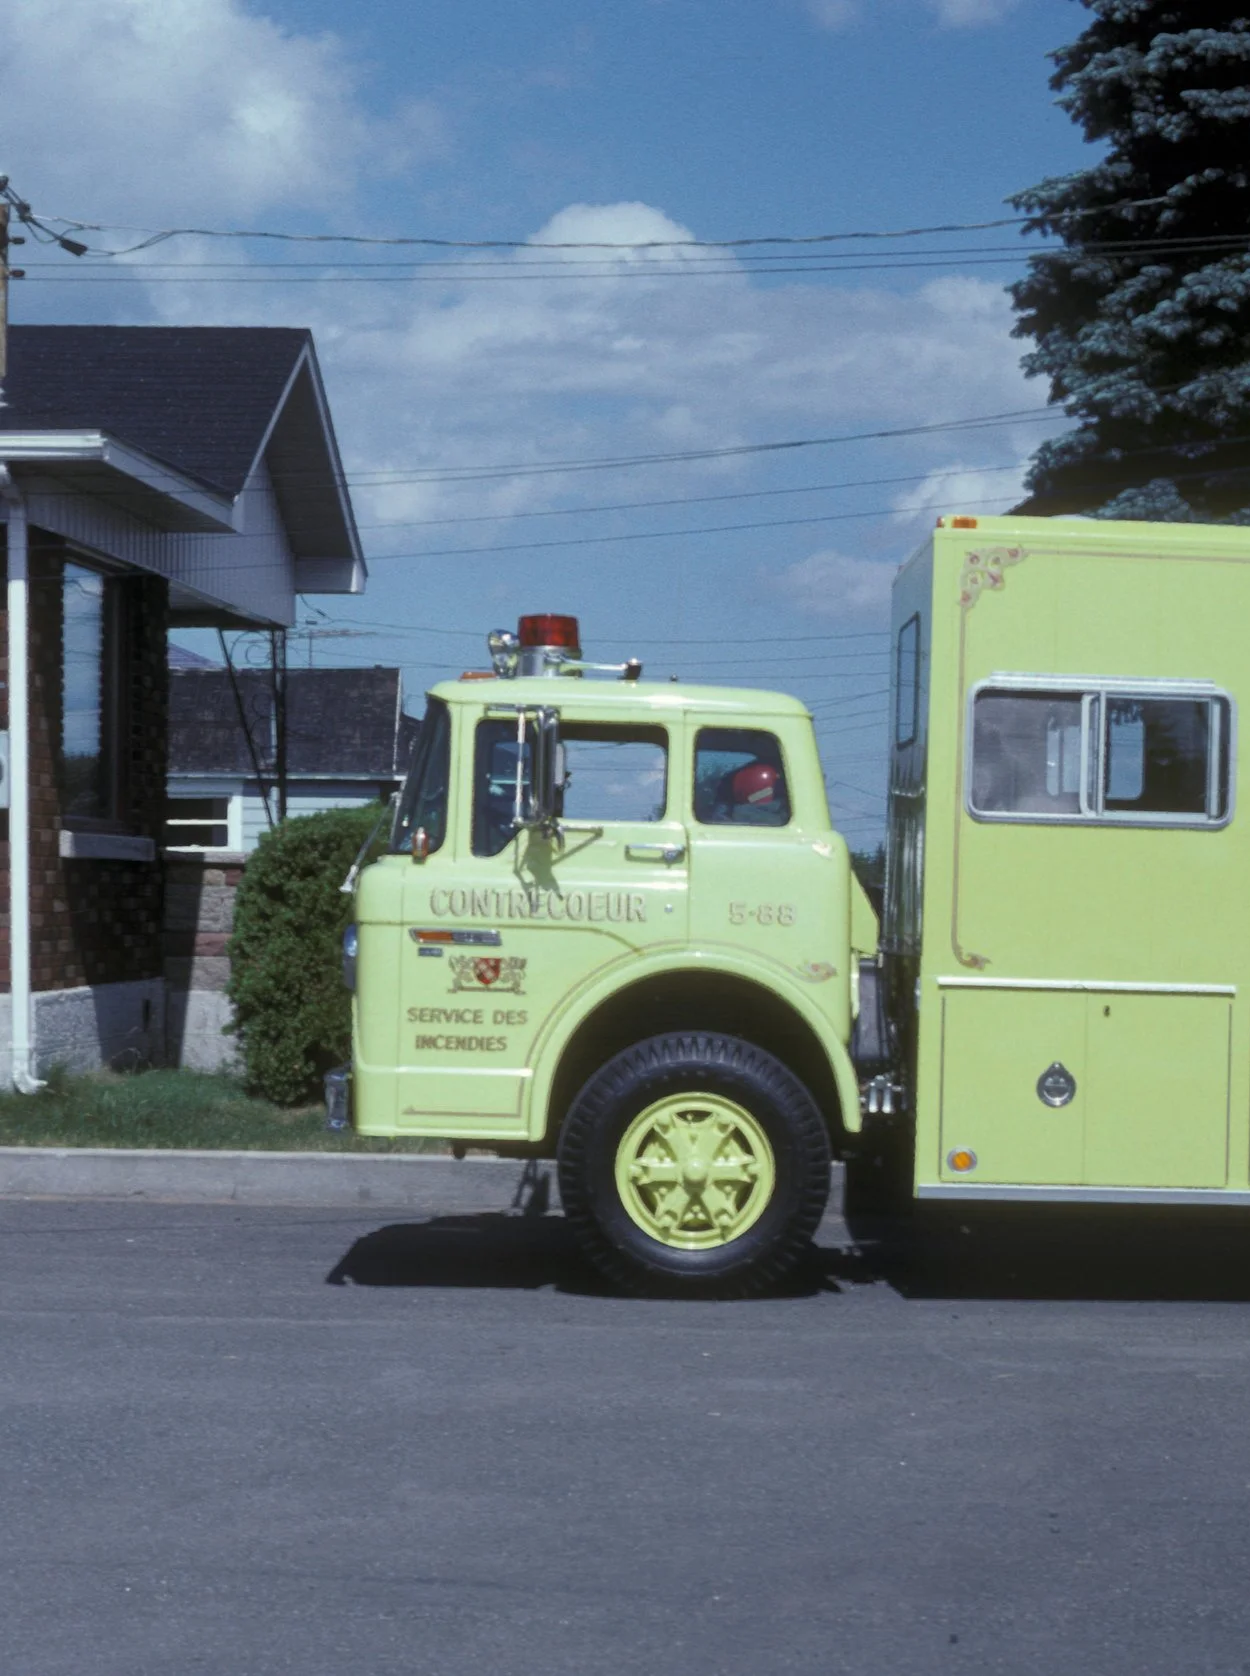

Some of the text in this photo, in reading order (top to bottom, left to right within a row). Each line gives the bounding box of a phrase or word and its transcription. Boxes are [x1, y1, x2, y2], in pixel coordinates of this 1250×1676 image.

[429, 887, 647, 923] CONTRECOEUR
[407, 1007, 528, 1026] SERVICE DES
[415, 1034, 508, 1052] INCENDIES
